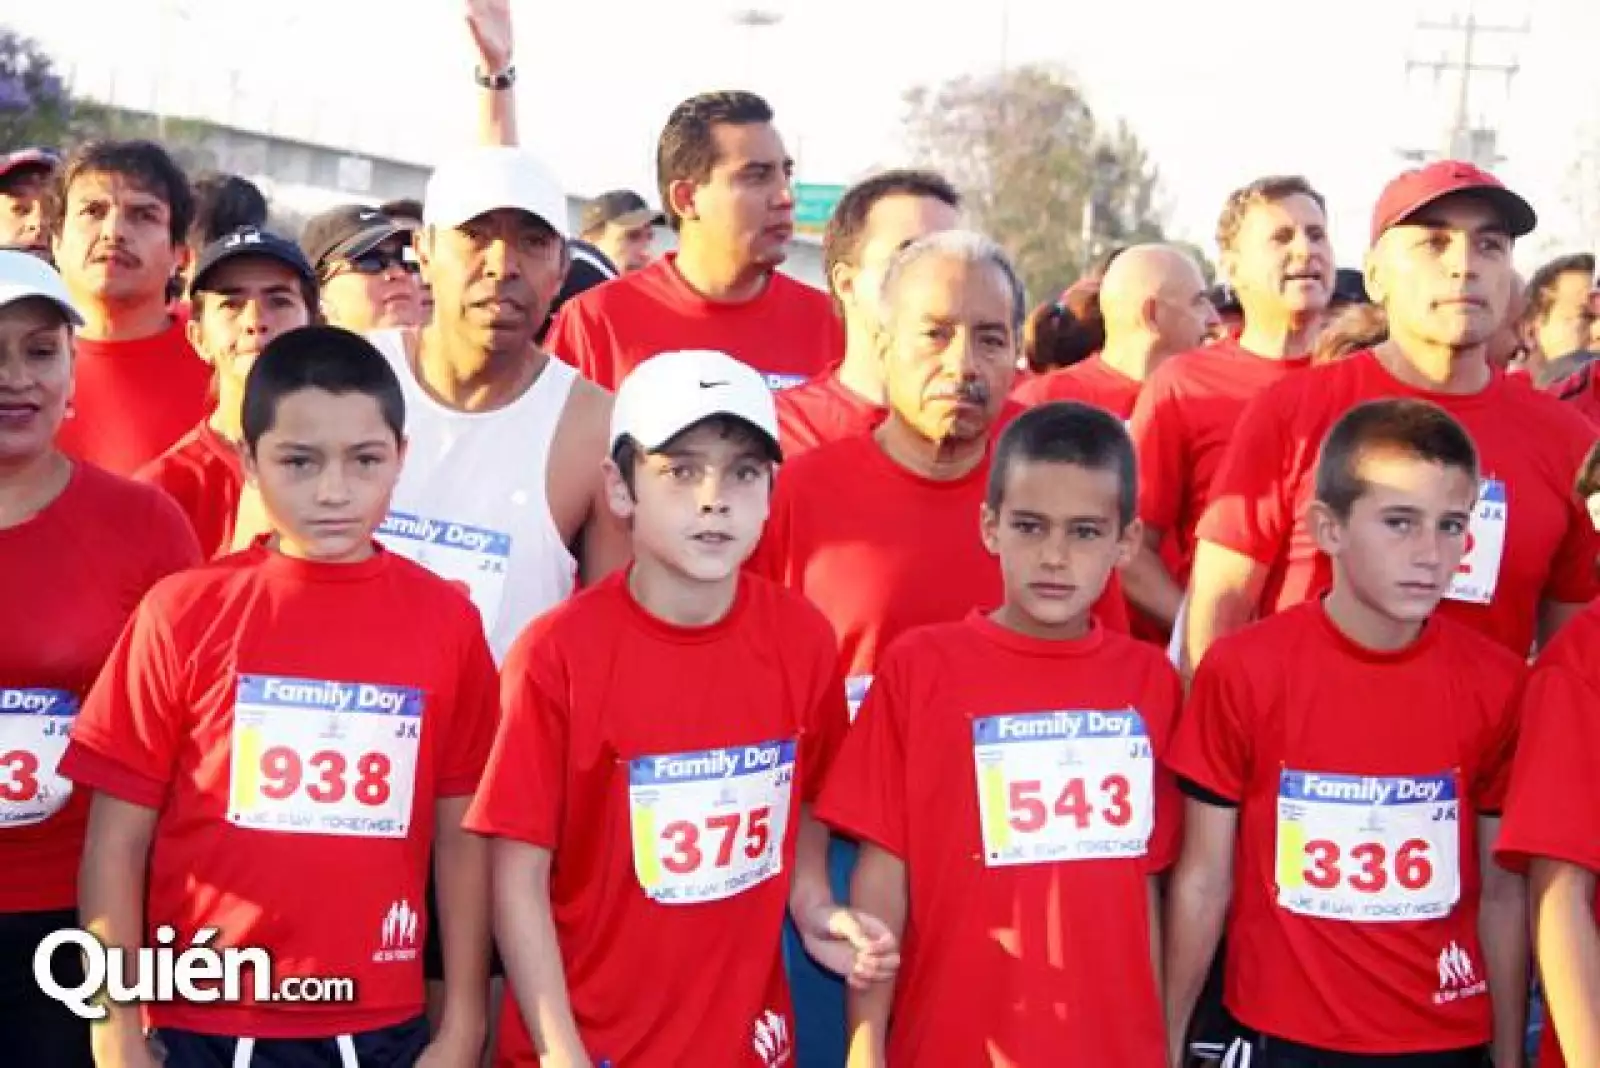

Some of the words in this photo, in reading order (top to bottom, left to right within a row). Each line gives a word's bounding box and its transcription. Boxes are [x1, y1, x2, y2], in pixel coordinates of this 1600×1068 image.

[446, 525, 492, 551] Day
[4, 688, 57, 714] Day
[264, 679, 352, 712] Family
[359, 686, 406, 714] Day
[1000, 711, 1082, 738] Family
[1089, 712, 1133, 736] Day
[0, 750, 40, 801] 3
[259, 744, 391, 806] 938
[654, 748, 739, 779] Family
[744, 745, 781, 770] Day
[1009, 773, 1133, 833] 543
[1303, 774, 1391, 804] Family
[1397, 779, 1444, 803] Day
[660, 806, 770, 875] 375
[1302, 837, 1432, 894] 336
